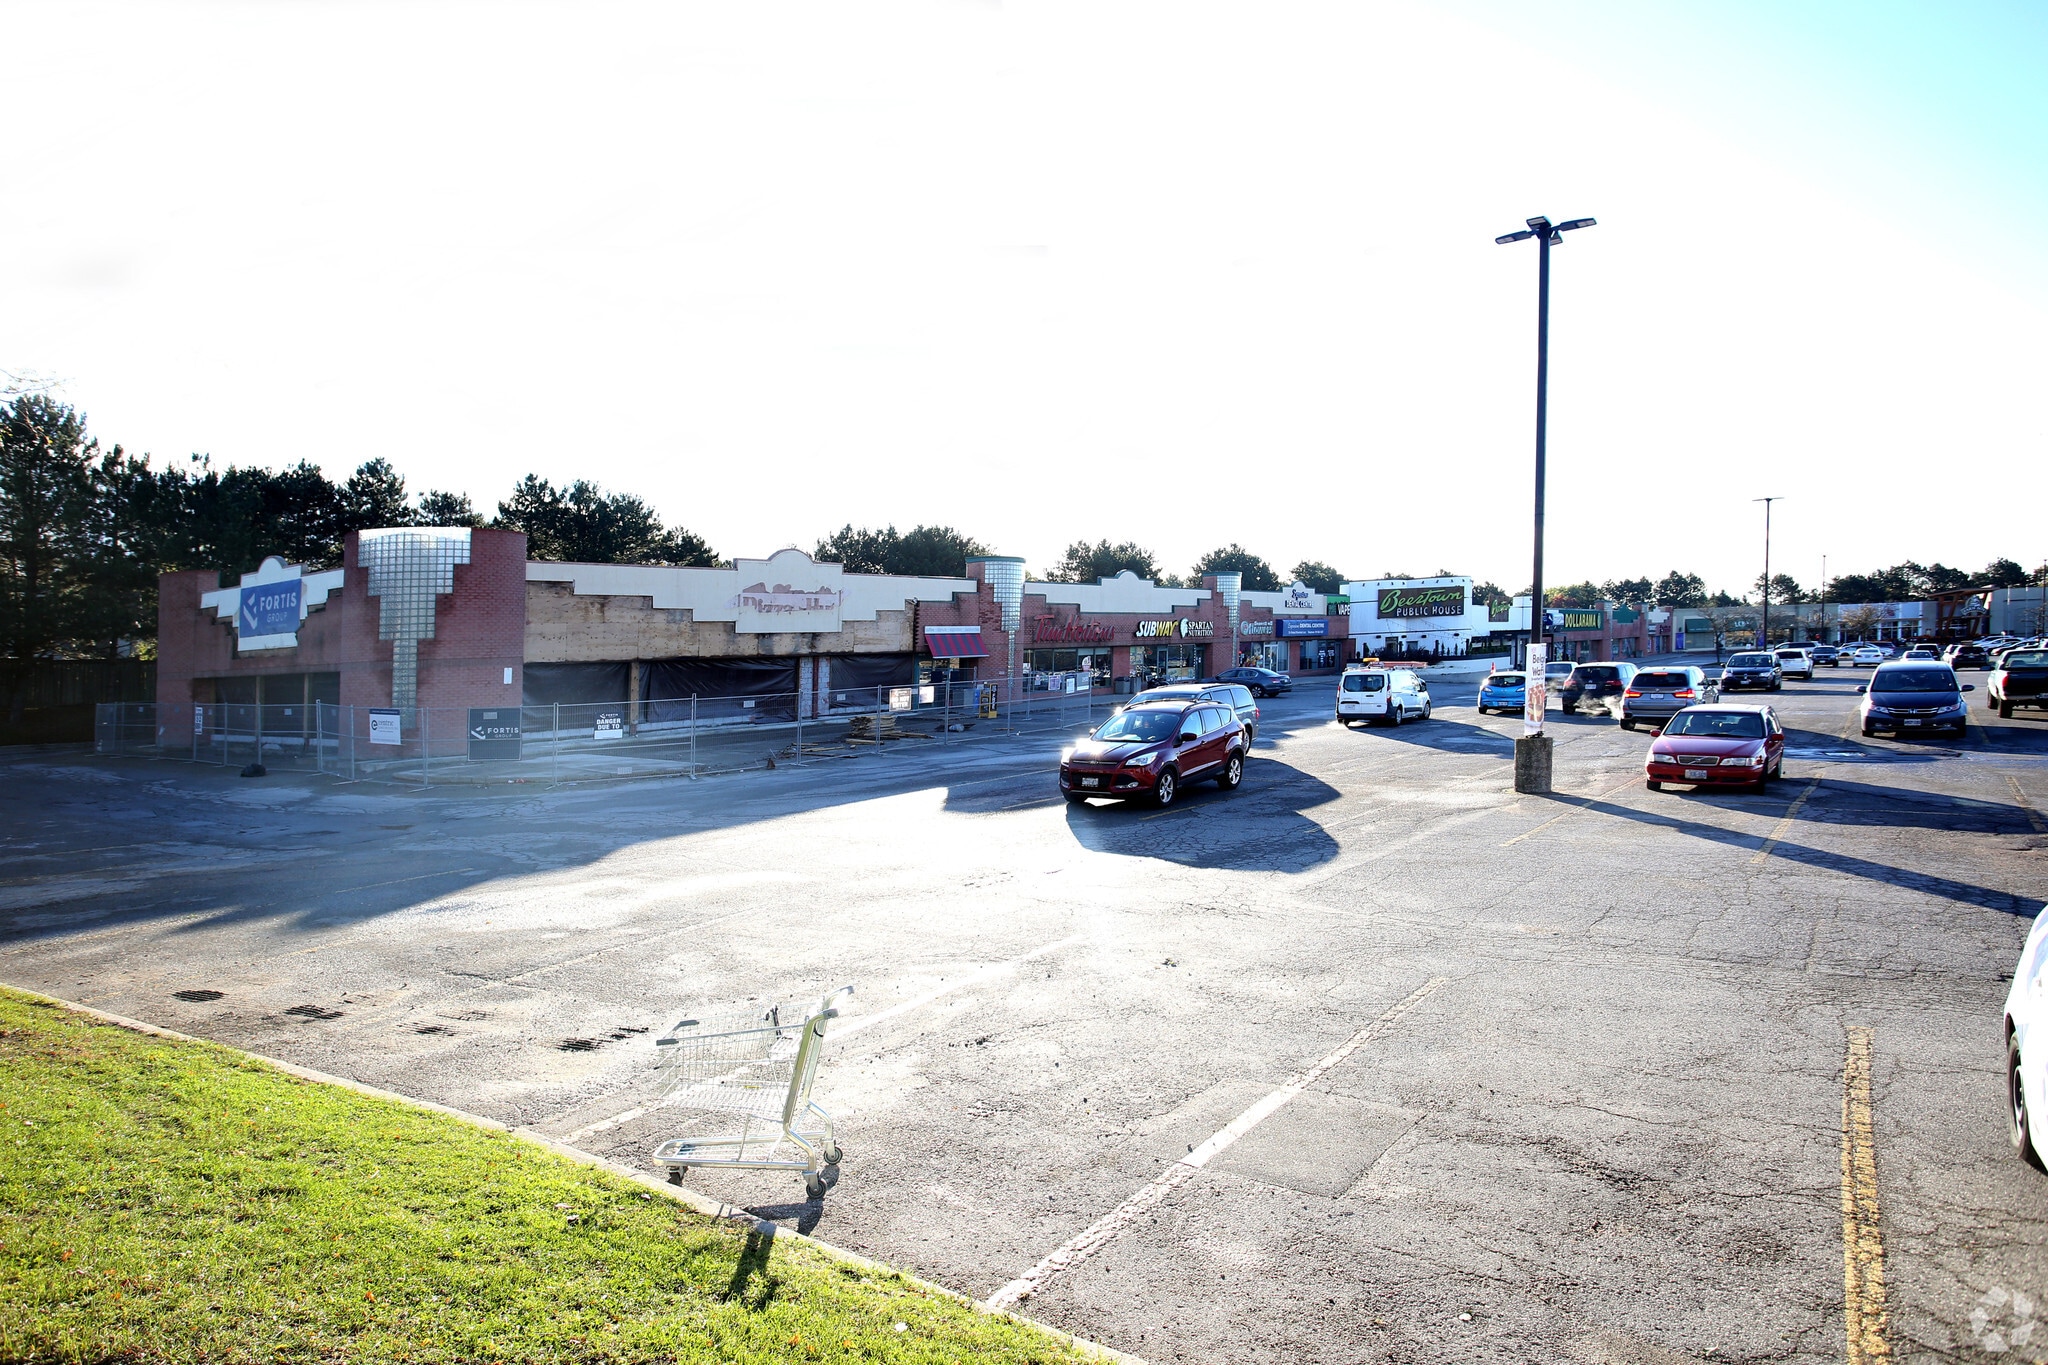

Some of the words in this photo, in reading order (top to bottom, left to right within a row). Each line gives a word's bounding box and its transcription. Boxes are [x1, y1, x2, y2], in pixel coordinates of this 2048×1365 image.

[260, 592, 297, 611] FORTIS
[1380, 589, 1463, 613] Beertown
[266, 611, 288, 623] GROUP
[1396, 607, 1428, 617] PUBLIC
[1432, 606, 1462, 616] HOUSE
[1188, 621, 1214, 630] SPARTAN
[1565, 613, 1596, 628] DOLLARAMA
[1034, 614, 1063, 643] Tim
[1063, 614, 1115, 642] Hortons
[1135, 620, 1179, 637] SUBWAY
[1188, 629, 1214, 637] NUTRITION
